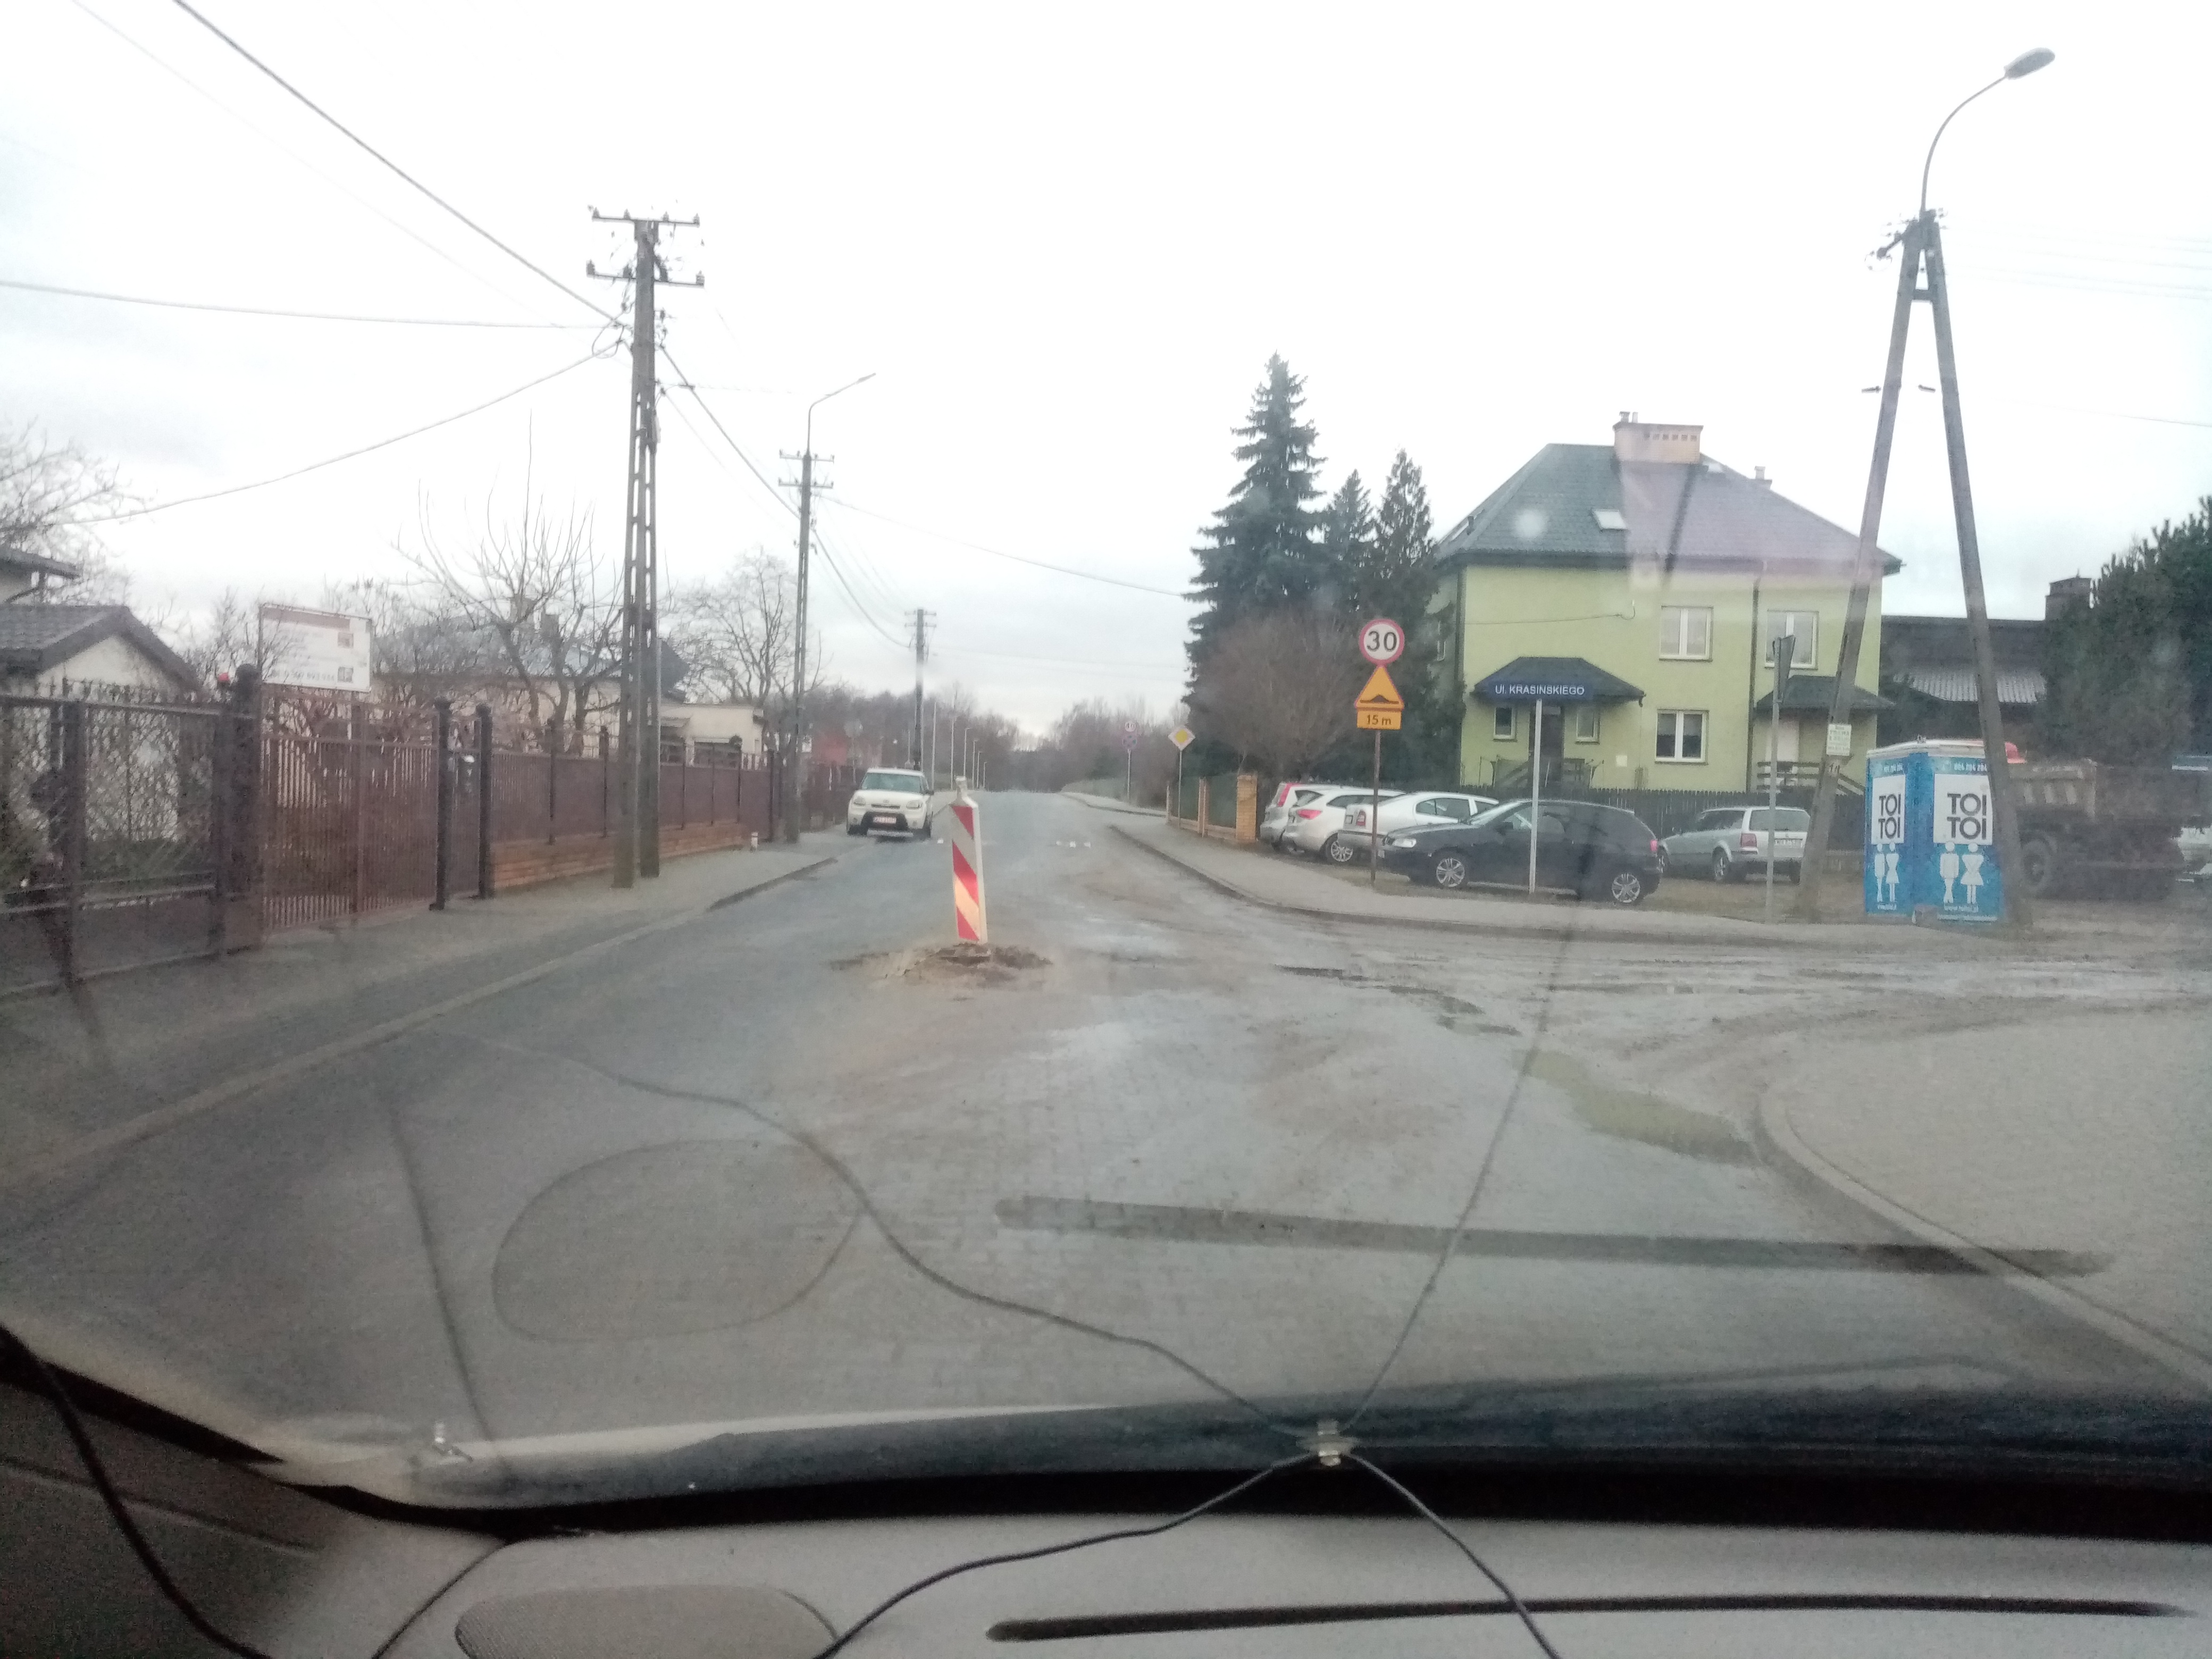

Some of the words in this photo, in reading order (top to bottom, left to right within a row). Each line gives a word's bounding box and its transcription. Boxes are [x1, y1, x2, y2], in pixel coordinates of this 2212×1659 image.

[1367, 631, 1397, 652] 30
[1366, 714, 1379, 726] 15
[1381, 717, 1392, 725] m
[1879, 793, 1901, 816] TOI
[1947, 793, 1987, 816] TOI
[1878, 816, 1900, 840] TOI
[1946, 816, 1987, 840] TOI
